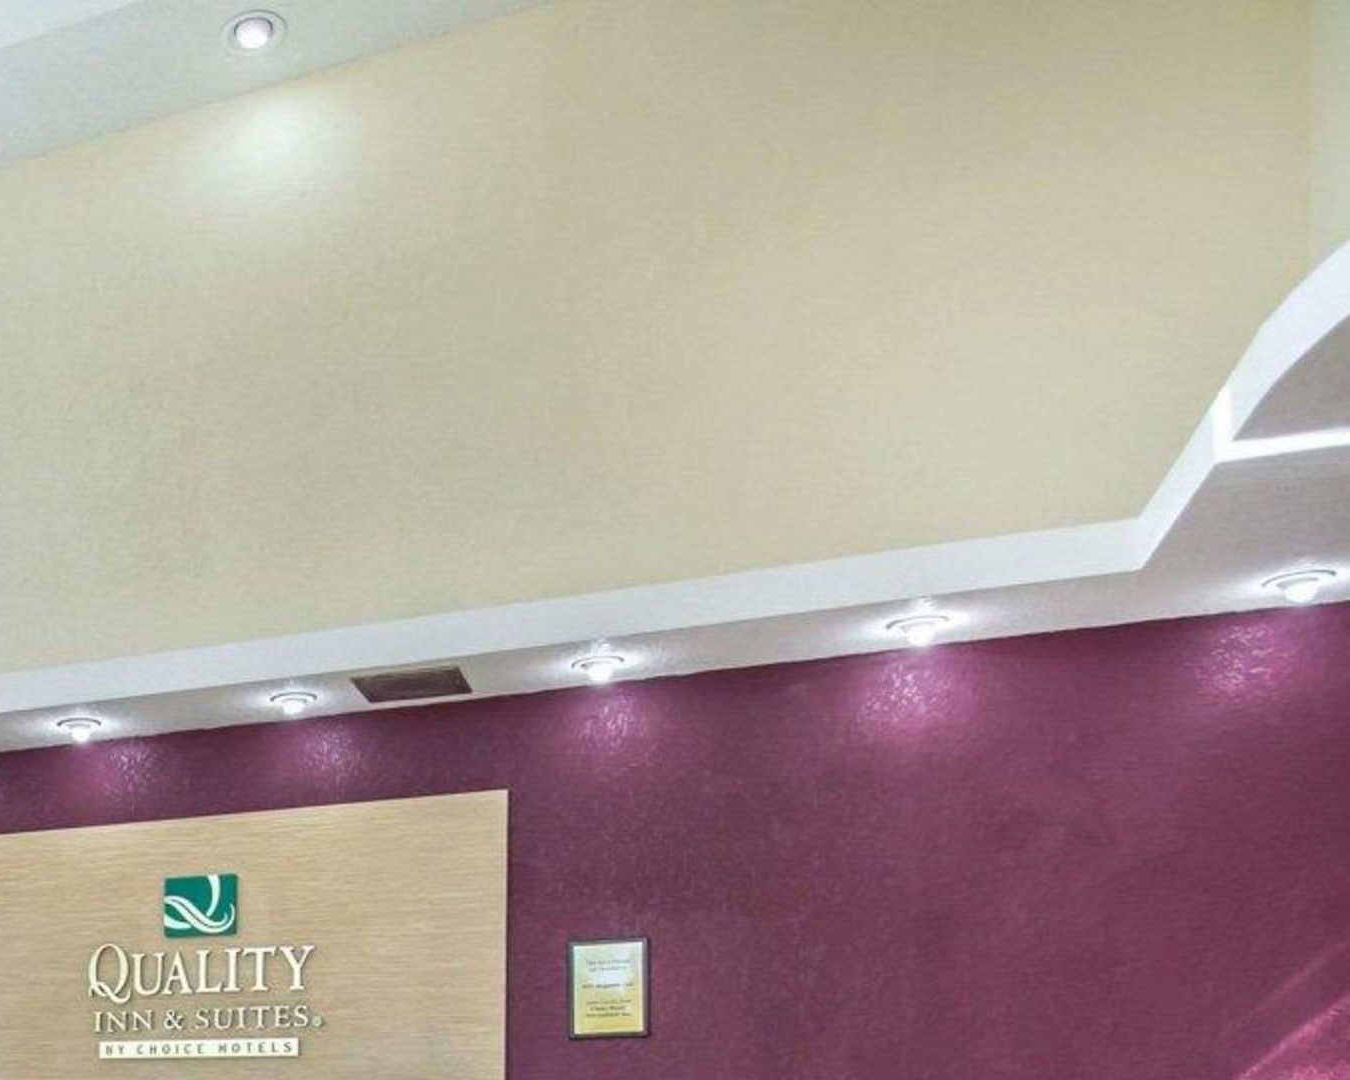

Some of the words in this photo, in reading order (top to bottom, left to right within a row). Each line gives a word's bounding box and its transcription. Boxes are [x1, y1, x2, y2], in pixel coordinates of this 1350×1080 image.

[88, 943, 316, 1005] QUALITY
[93, 1009, 153, 1034] INN
[163, 1008, 184, 1030] &
[105, 1042, 126, 1056] BY
[136, 1041, 206, 1056] CHOICE
[218, 1040, 293, 1055] HOTELS
